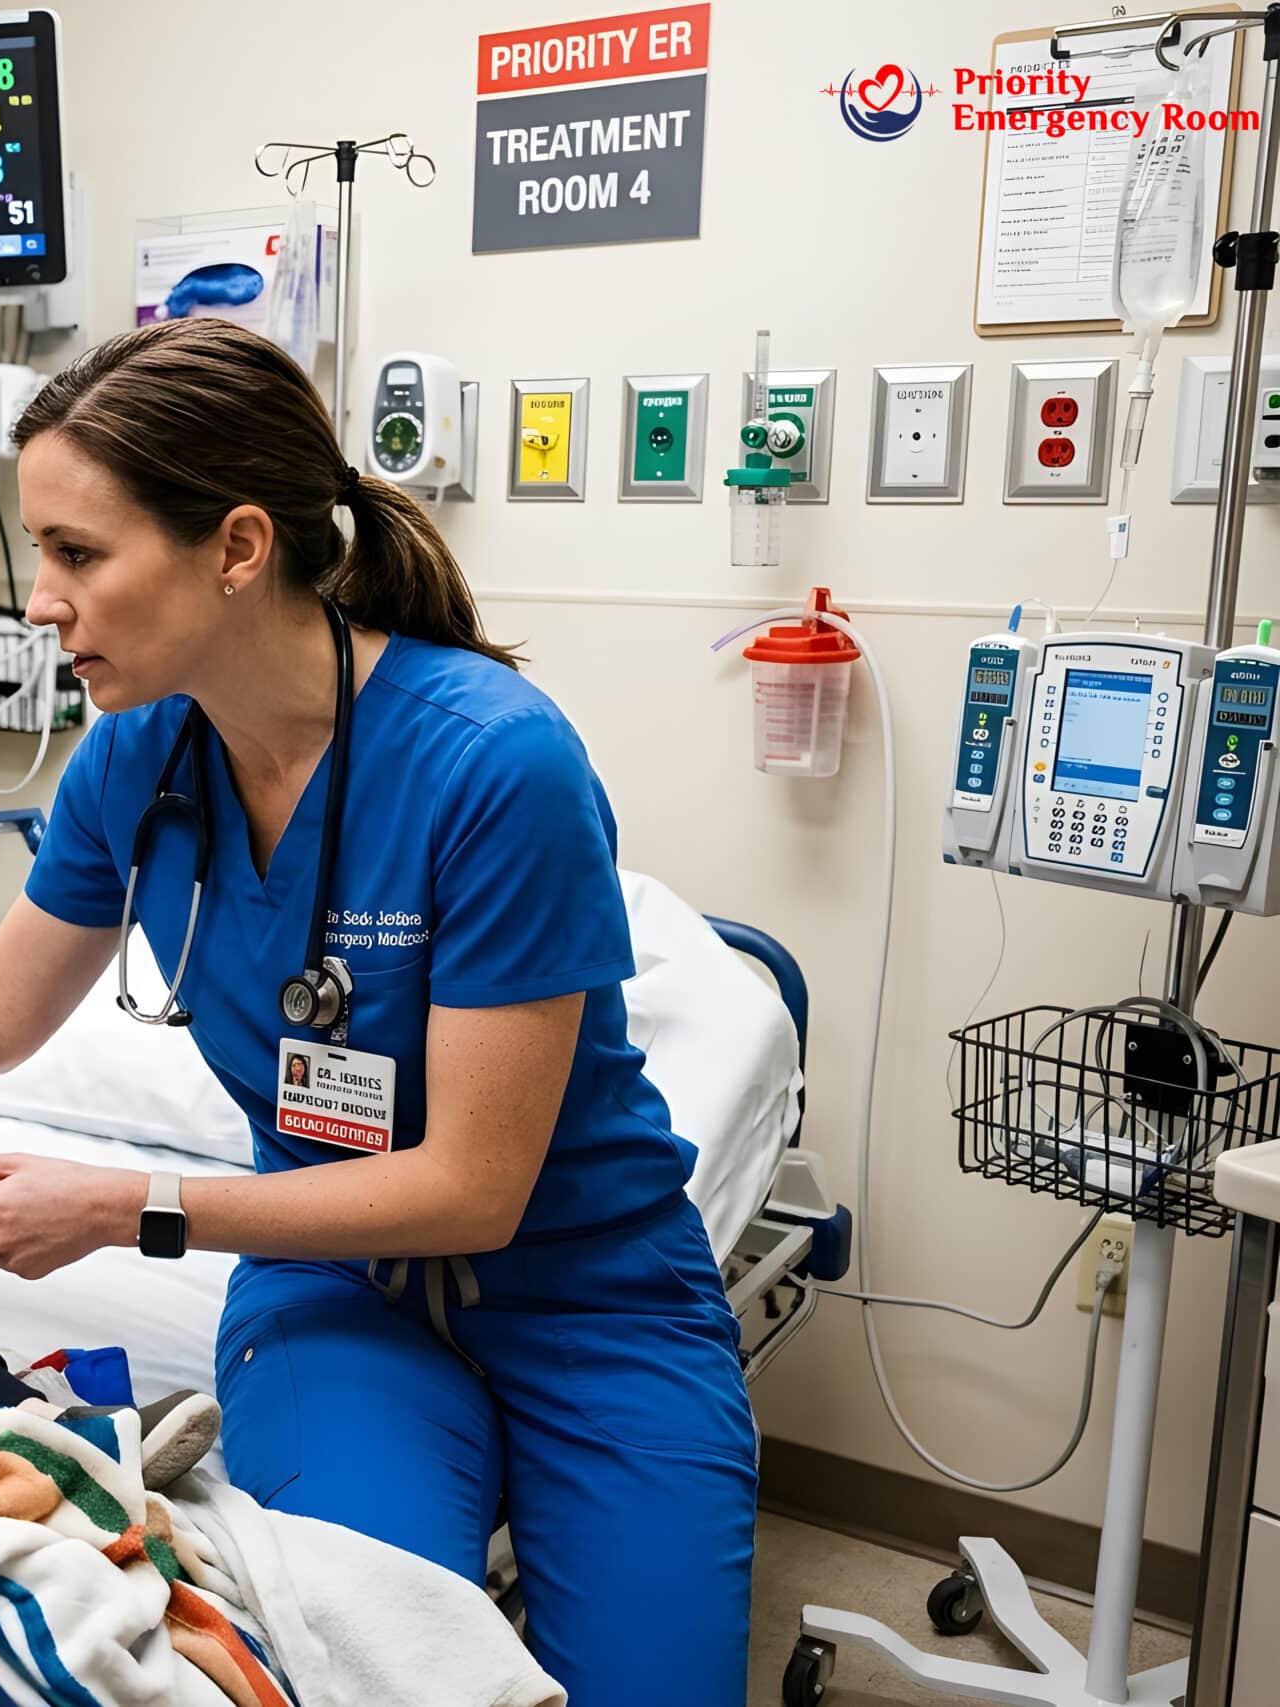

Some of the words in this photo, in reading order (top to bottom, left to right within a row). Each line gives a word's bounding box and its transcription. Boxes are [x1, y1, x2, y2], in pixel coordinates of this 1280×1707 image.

[491, 27, 638, 80] PRIORITY
[649, 21, 691, 61] ER
[487, 110, 691, 165] TREATMENT
[519, 172, 618, 215] ROOM
[629, 169, 651, 205] 4
